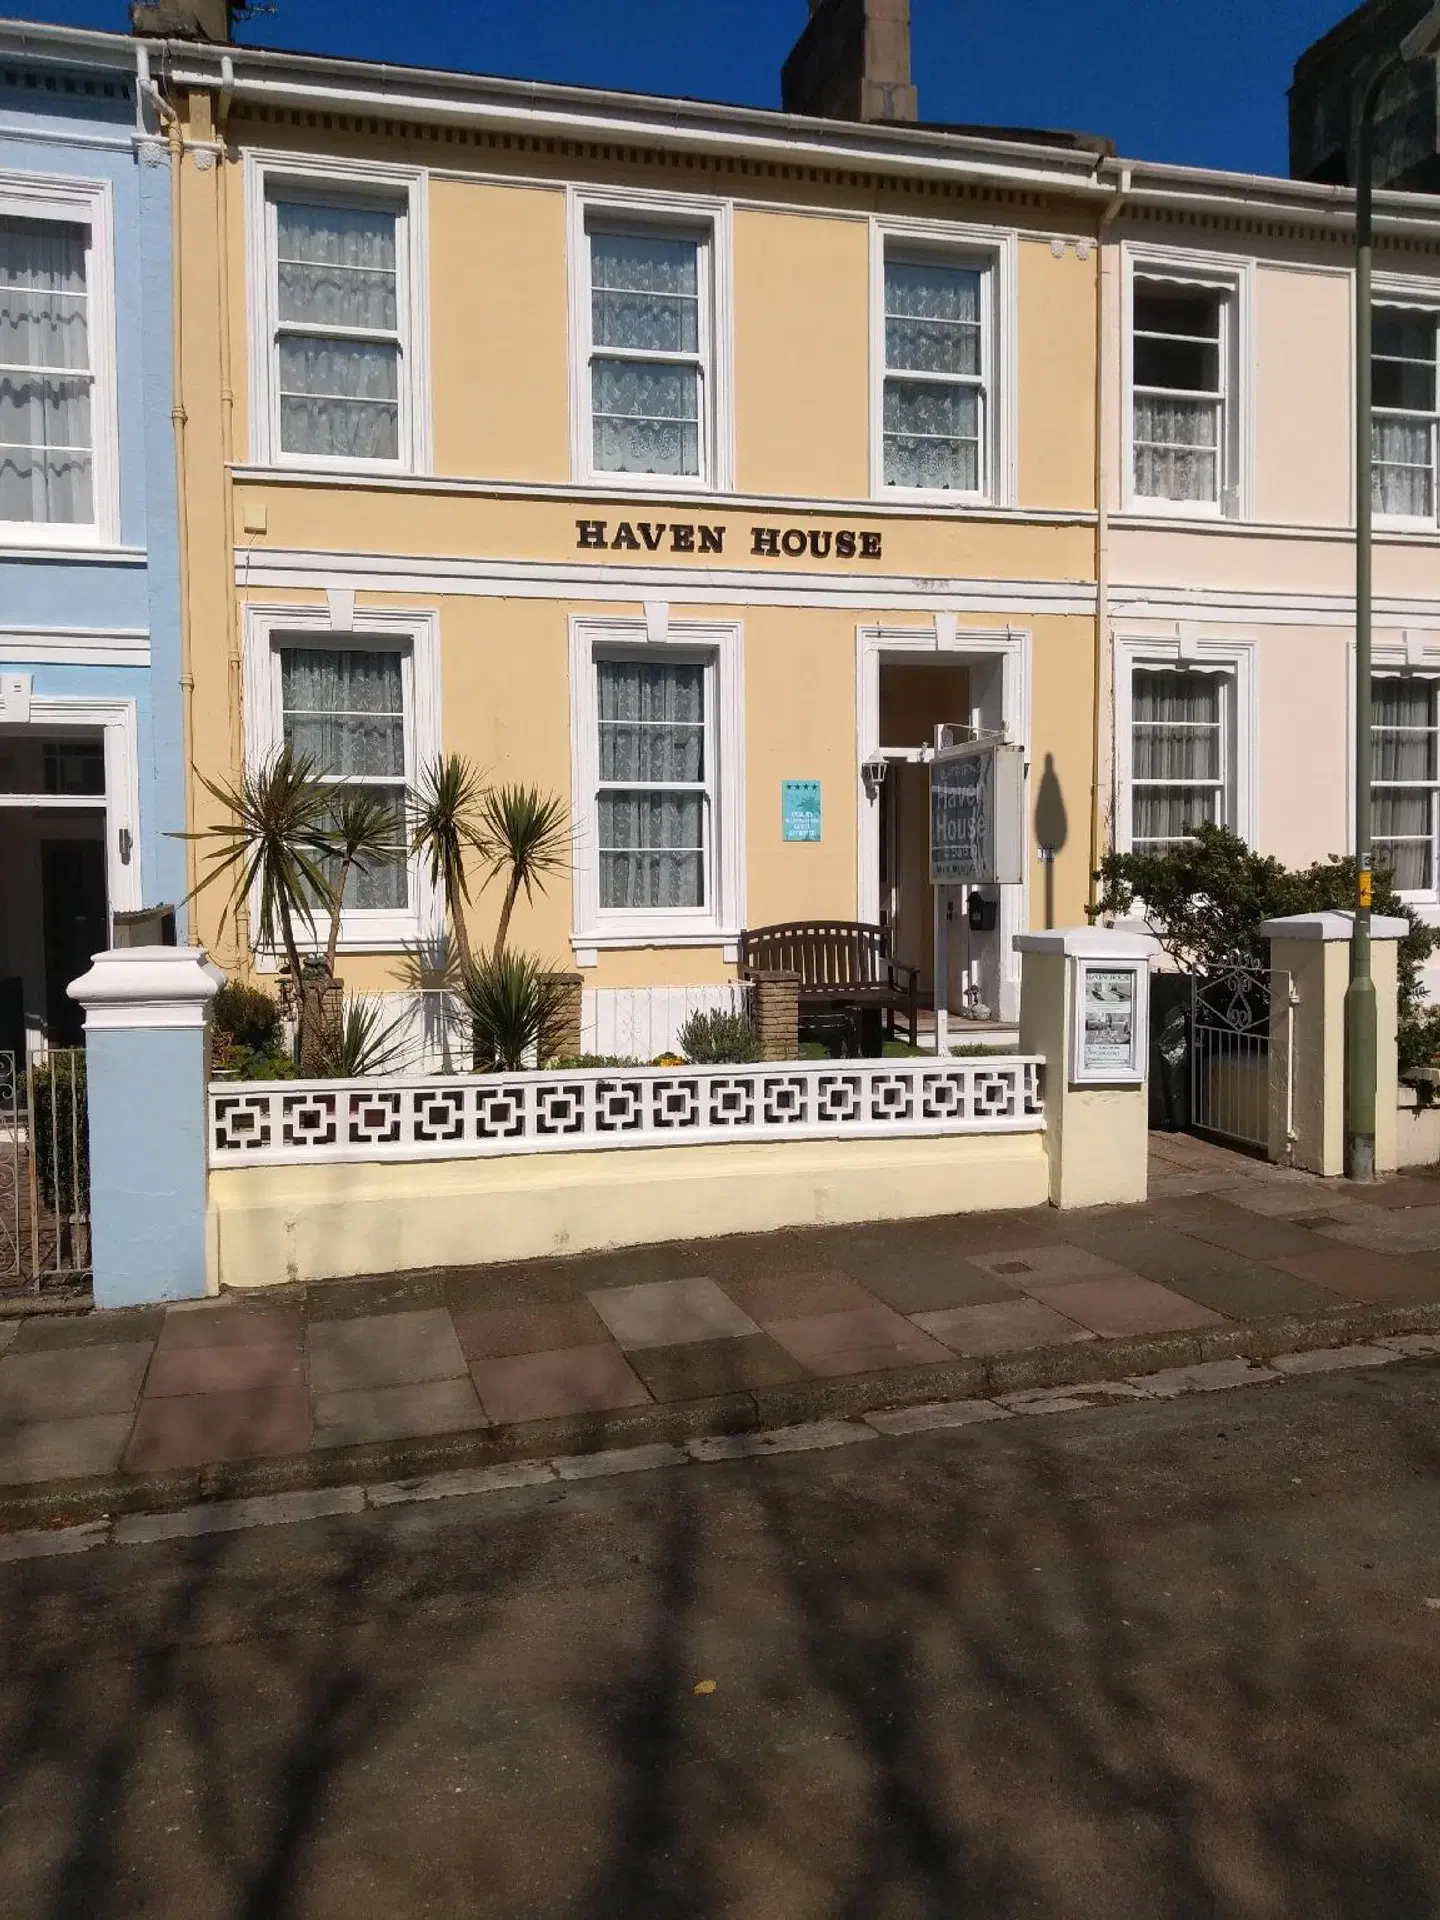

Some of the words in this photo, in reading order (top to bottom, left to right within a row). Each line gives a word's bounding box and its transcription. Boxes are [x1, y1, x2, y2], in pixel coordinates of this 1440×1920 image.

[575, 520, 726, 553] HAVEN
[750, 527, 883, 559] HOUSE
[936, 812, 988, 841] House
